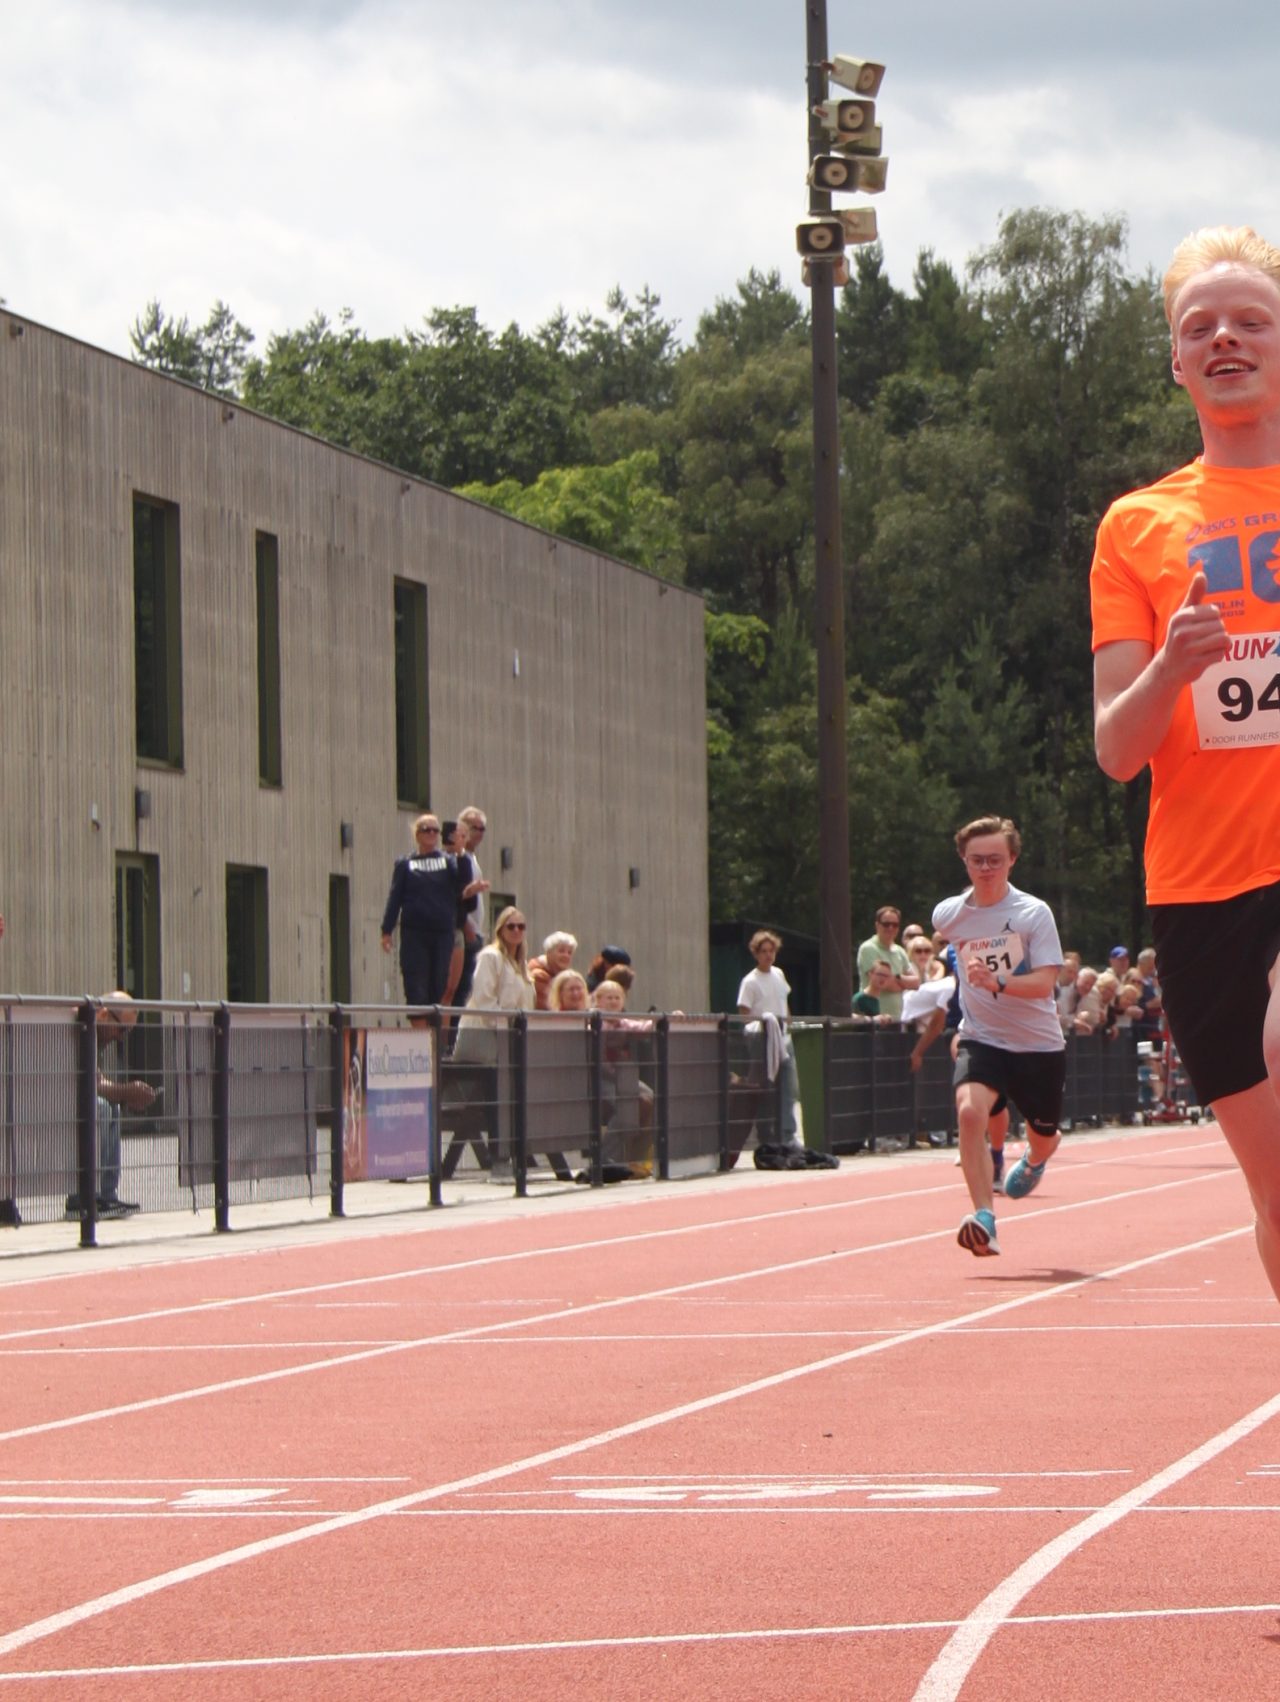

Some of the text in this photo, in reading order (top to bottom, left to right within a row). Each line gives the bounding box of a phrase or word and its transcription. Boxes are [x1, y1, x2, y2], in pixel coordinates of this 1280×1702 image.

[1212, 735, 1236, 745] DOOR
[1238, 730, 1280, 742] RUNNERS
[975, 952, 1011, 972] 51
